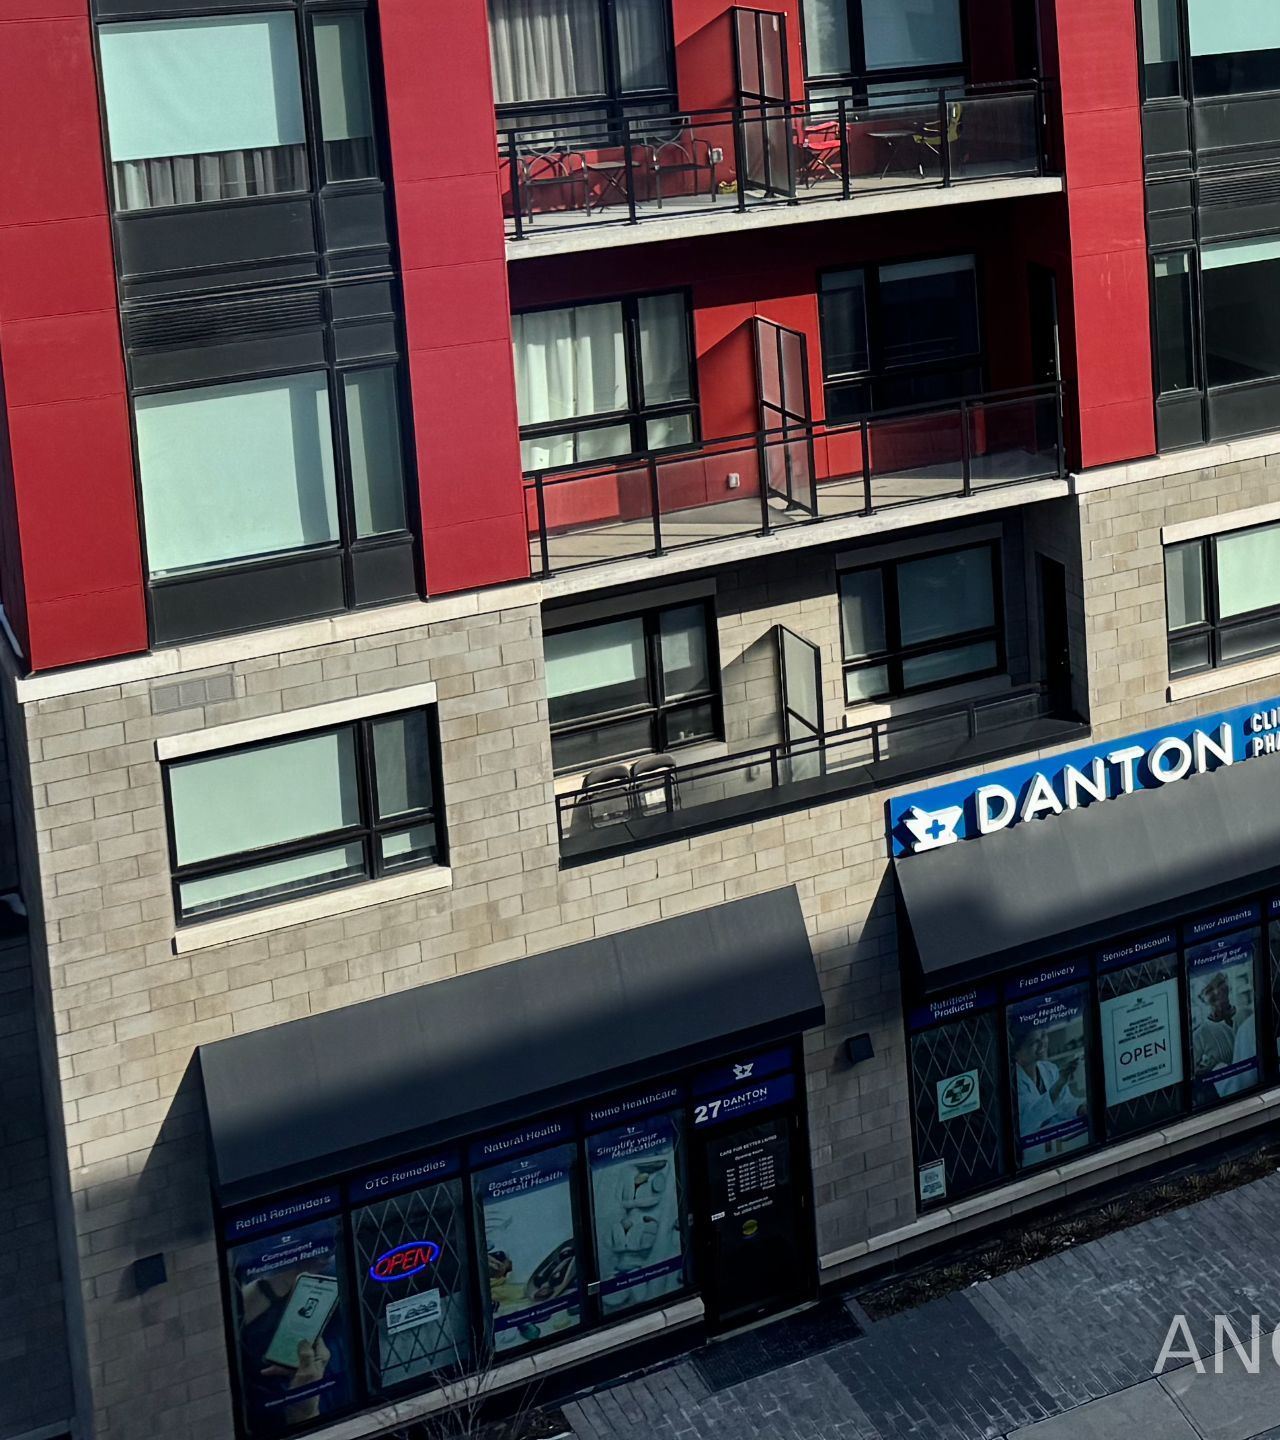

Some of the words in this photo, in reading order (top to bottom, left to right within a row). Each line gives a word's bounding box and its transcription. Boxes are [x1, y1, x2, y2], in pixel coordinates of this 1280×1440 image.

[974, 721, 1233, 836] DANTON
[1193, 921, 1216, 934] Minor
[1217, 909, 1252, 926] Ailments
[1102, 948, 1134, 963] Seniors
[1134, 934, 1171, 952] Discount
[1018, 974, 1039, 989] Free
[1040, 964, 1076, 983] Delivery
[930, 990, 977, 1012] Nutritional
[934, 1001, 974, 1019] Products
[1019, 1010, 1039, 1025] Your
[1033, 1014, 1049, 1027] Our
[1049, 1006, 1079, 1023] Priority
[1119, 1038, 1167, 1065] OPEN
[590, 1103, 621, 1121] Home
[622, 1086, 678, 1113] Healthcare
[693, 1100, 722, 1124] 27
[723, 1087, 768, 1109] DANTON
[484, 1133, 524, 1155] Natural
[525, 1122, 562, 1142] Health
[597, 1138, 635, 1159] Simplify
[636, 1131, 659, 1148] your
[612, 1136, 667, 1160] Medications
[365, 1174, 390, 1191] OTC
[391, 1158, 447, 1184] Remedies
[488, 1175, 517, 1192] Boost
[518, 1169, 542, 1187] your
[492, 1182, 528, 1198] Overall
[529, 1169, 564, 1188] Health
[235, 1211, 268, 1231] Refill
[269, 1193, 332, 1221] Reminders
[246, 1255, 299, 1277] Medication
[299, 1244, 330, 1261] Refills
[261, 1240, 313, 1263] Convenient
[374, 1247, 432, 1277] OPEN
